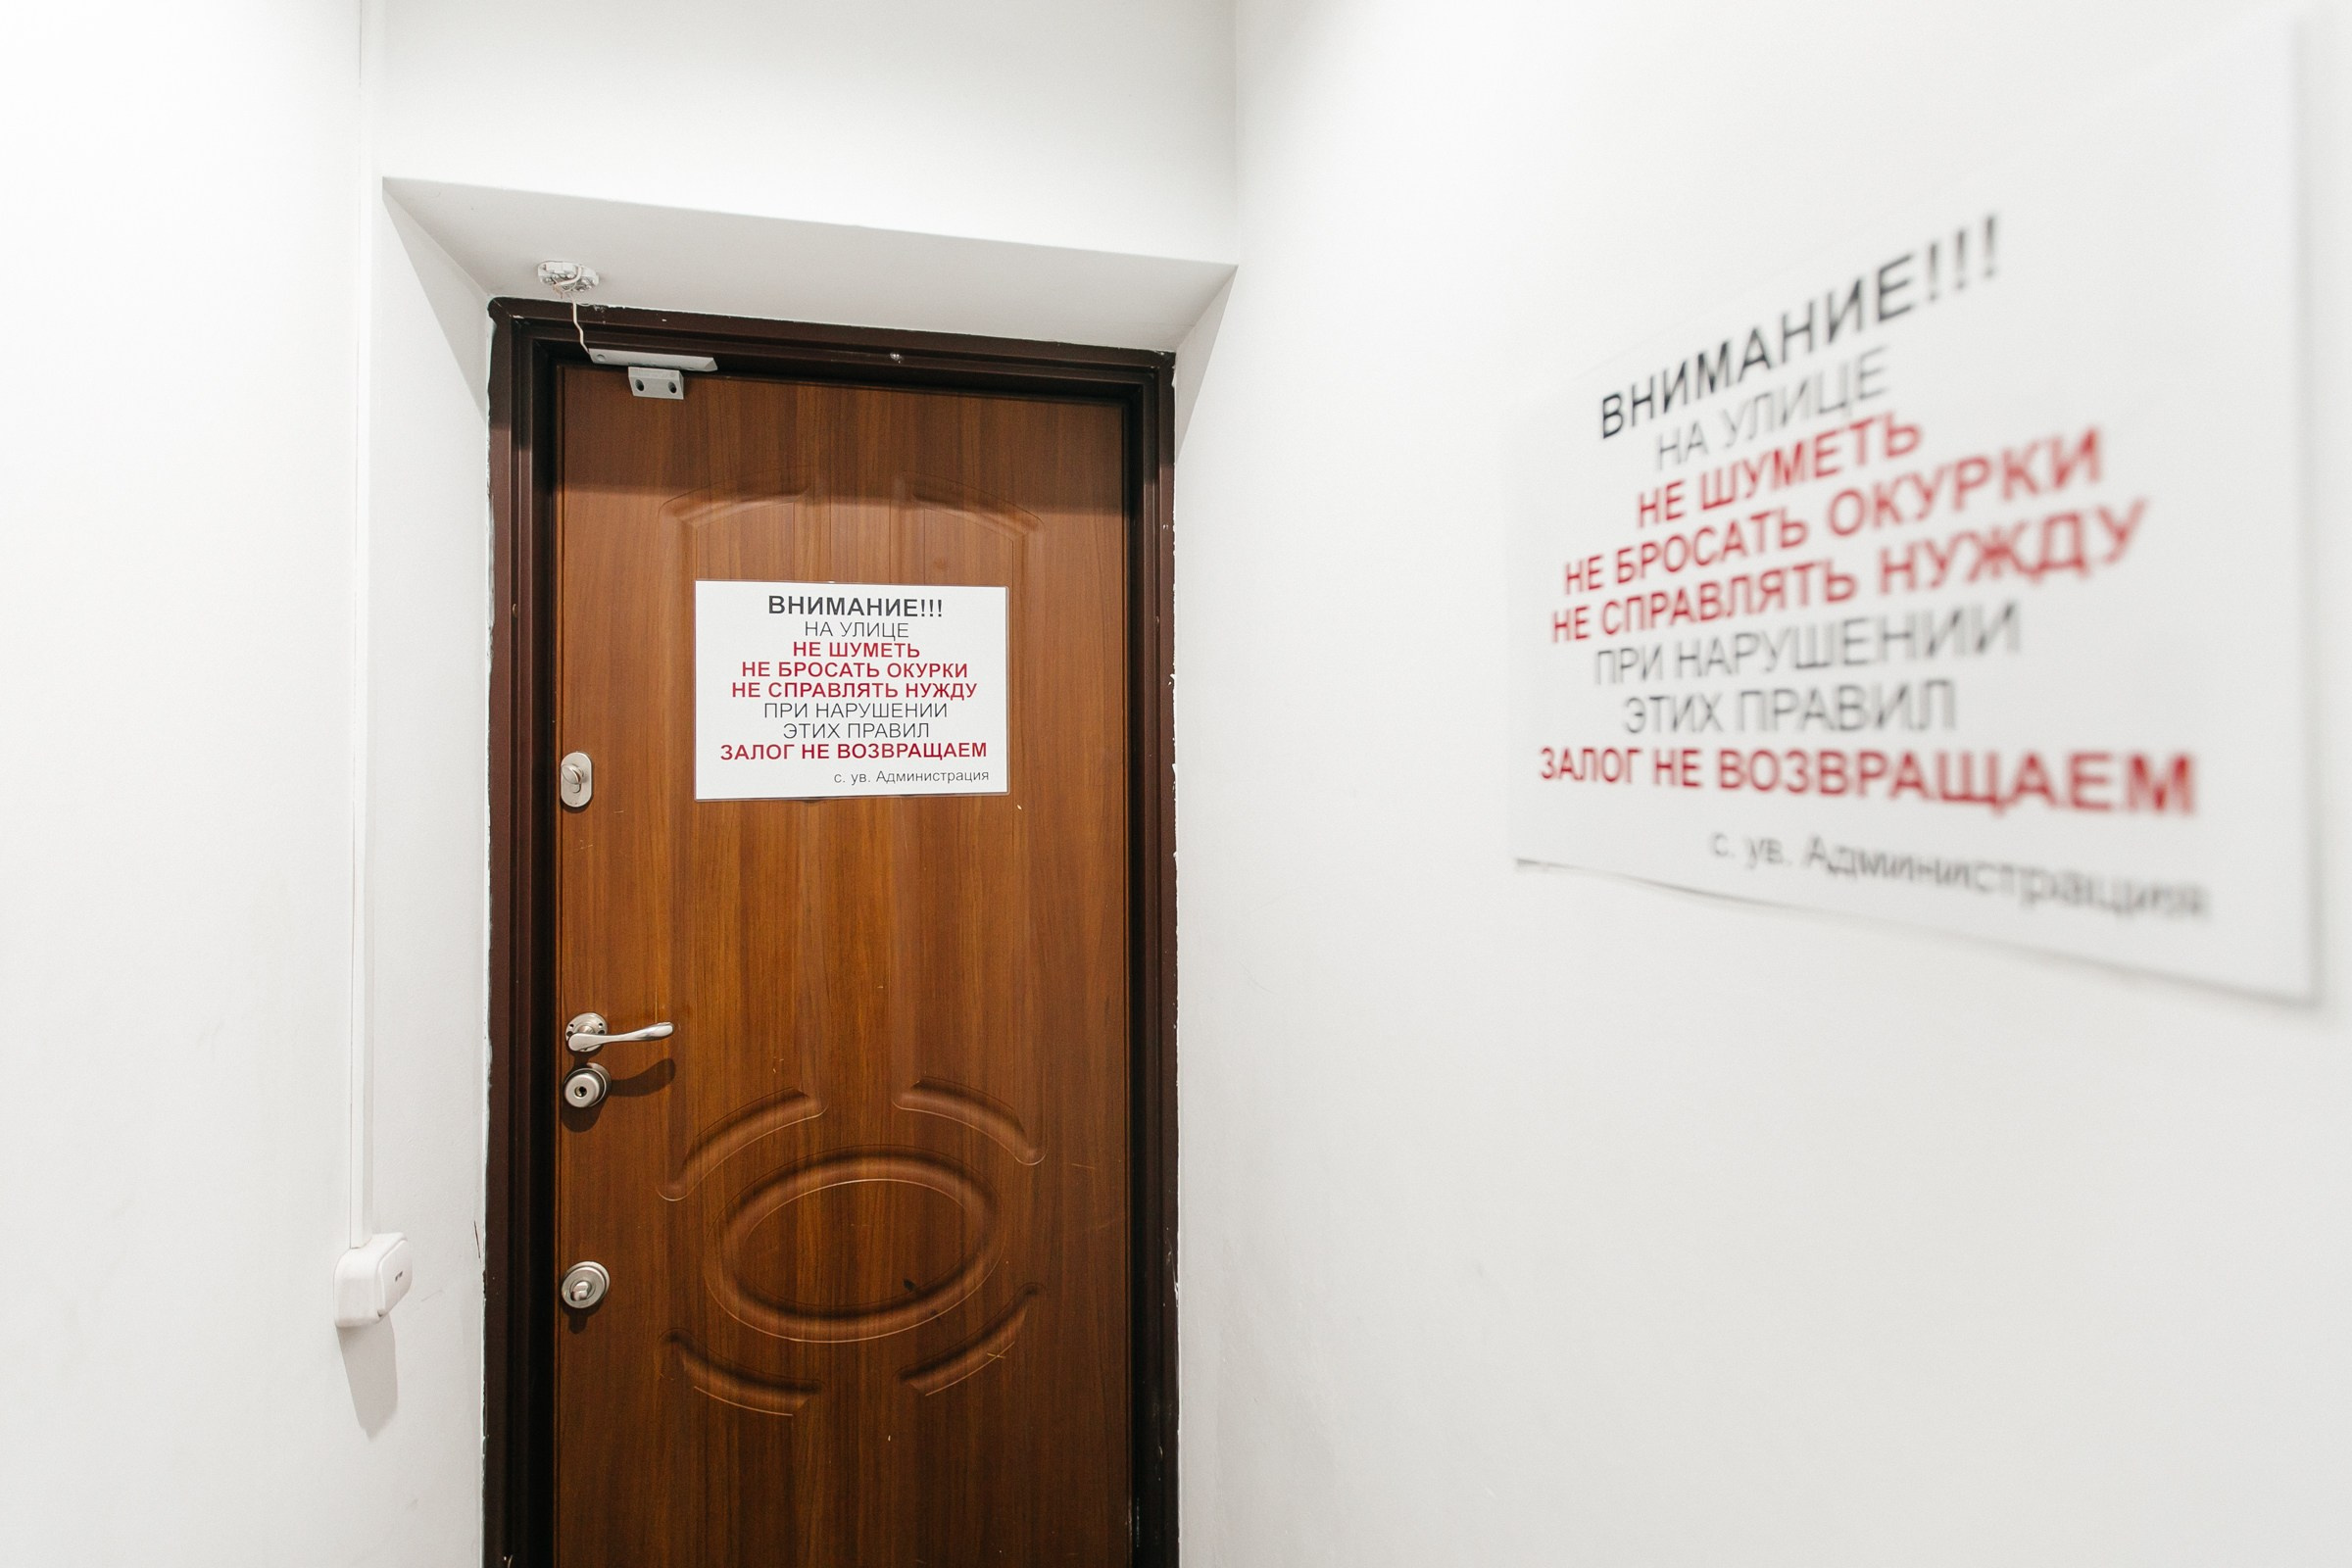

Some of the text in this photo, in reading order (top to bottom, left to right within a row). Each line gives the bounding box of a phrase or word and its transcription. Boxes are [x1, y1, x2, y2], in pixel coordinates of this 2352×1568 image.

[1601, 214, 1998, 440] ВНИМАНИЕ!!!
[1656, 343, 1889, 470] НА УЛИЦЕ
[1637, 410, 1924, 529] НЕ ШУМЕТЬ
[1565, 425, 2104, 596] НЕ БРОСАТЬ ОКУРКИ
[1552, 497, 2150, 643] НЕ СПРАВЛЯТЬ НУЖДУ
[769, 596, 942, 616] ВНИМАНИЕ!!!
[806, 621, 908, 641] НА УЛИЦЕ
[794, 642, 919, 658] НЕ ШУМЕТЬ
[1593, 600, 2023, 686] ПРИ НАРУШЕНИИ
[743, 662, 967, 678] НЕ БРОСАТЬ ОКУРКИ
[733, 682, 977, 701] НЕ СПРАВЛЯТЬ НУЖДУ
[765, 703, 947, 717] ПРИ НАРУШЕНИИ
[1621, 678, 1959, 734] ЭТИХ ПРАВИЛ
[784, 723, 928, 739] ЭТИХ ПРАВИЛ
[721, 743, 986, 760] ЗАЛОГ НЕ ВОЗВРАЩАЕМ
[834, 771, 988, 785] с. ув. Администрация
[1540, 747, 2198, 816] ЗАЛОГ НЕ ВОЗВРАЩАЕМ
